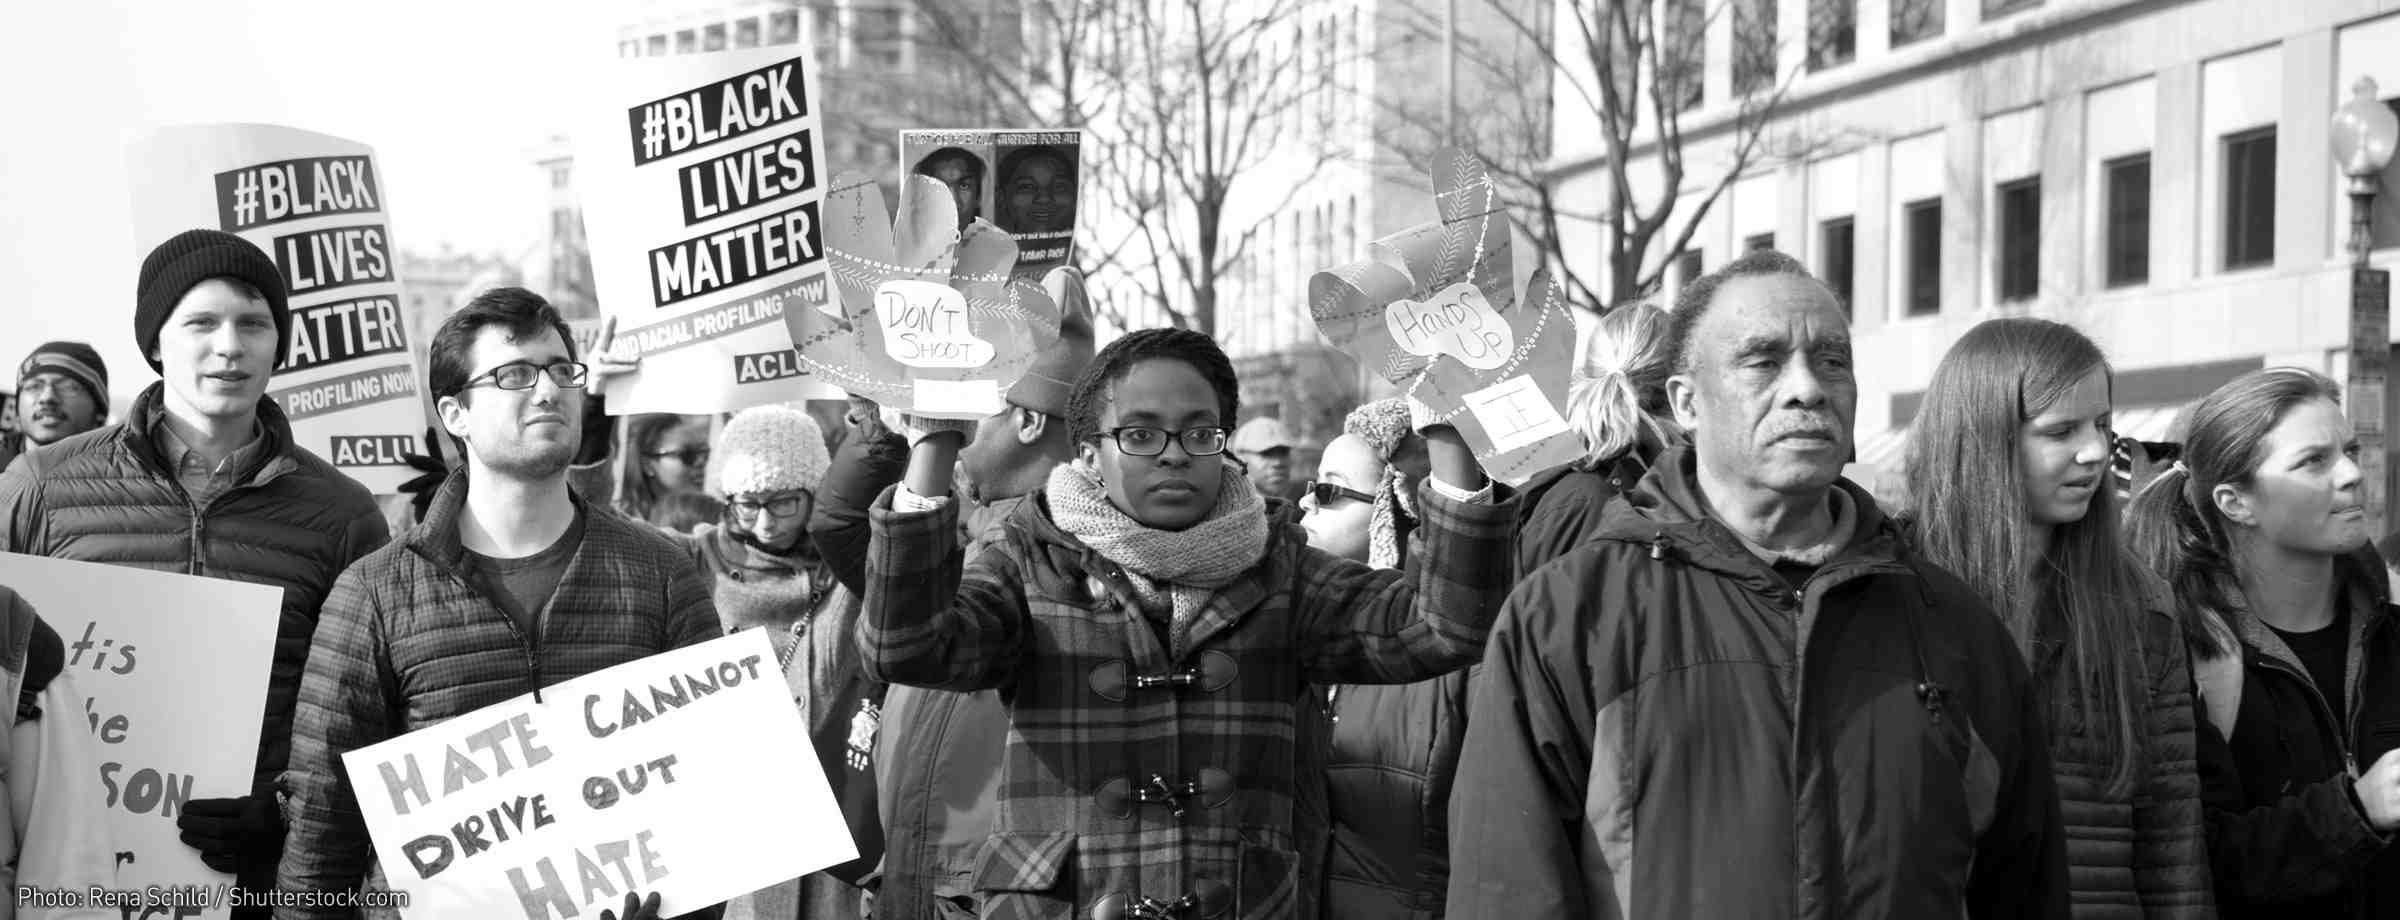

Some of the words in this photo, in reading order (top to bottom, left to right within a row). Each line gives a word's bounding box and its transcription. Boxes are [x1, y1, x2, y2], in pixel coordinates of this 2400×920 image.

[642, 64, 800, 160] #BLACK
[234, 160, 375, 227] #BLACK
[690, 138, 806, 219] LIVES
[287, 228, 387, 291] LIVES
[655, 209, 814, 302] MATTER
[278, 300, 403, 373] ATTER
[693, 295, 784, 338] PROFILING
[880, 291, 960, 334] DON'T
[288, 376, 381, 416] PROFILING
[383, 371, 416, 396] NOW
[336, 436, 413, 466] ACLU
[377, 712, 553, 816] HATE
[583, 653, 762, 740] CANNOT
[402, 793, 556, 881] DRIVE
[582, 754, 679, 811] OUT
[504, 829, 671, 920] HATE
